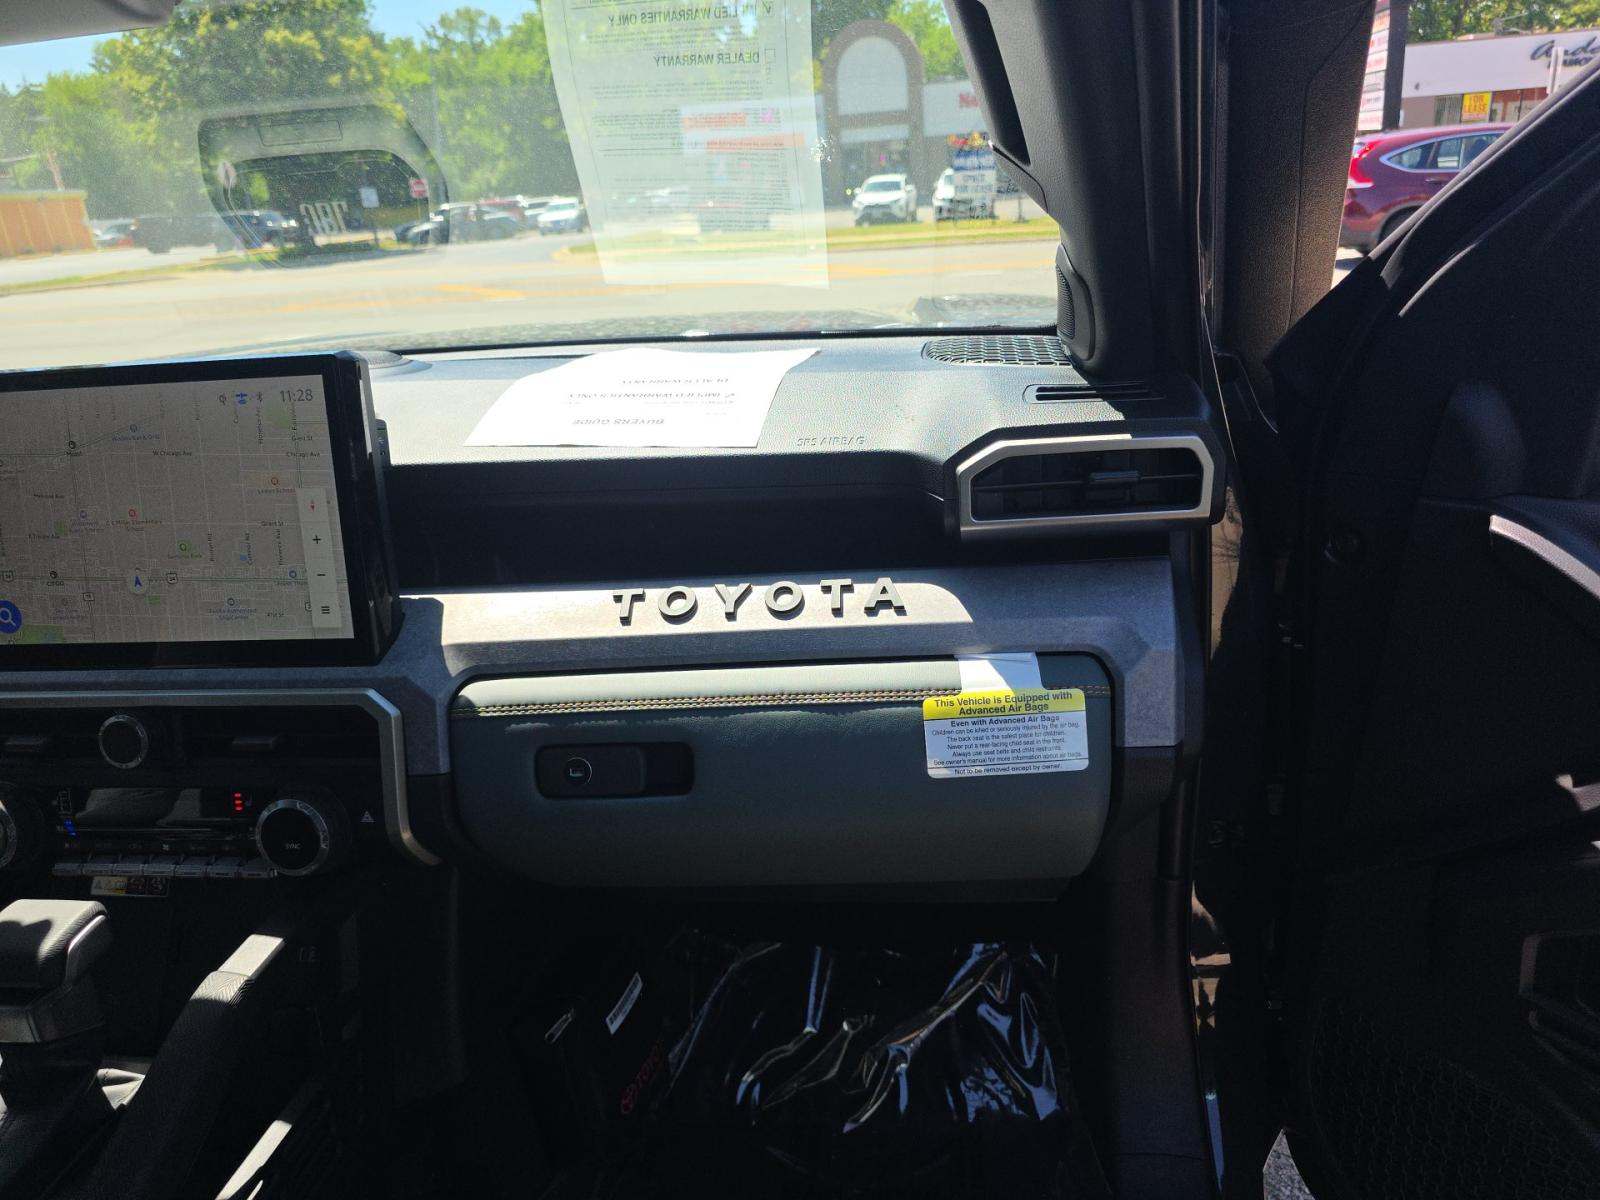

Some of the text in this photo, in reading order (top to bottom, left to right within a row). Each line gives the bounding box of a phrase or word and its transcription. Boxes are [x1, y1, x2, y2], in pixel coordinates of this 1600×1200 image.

[279, 388, 314, 403] 11:28
[612, 577, 907, 626] TOYOTA
[934, 691, 1073, 708] This Vehicle is Equipped with
[959, 703, 1049, 716] Advanced Air Bags
[988, 716, 1026, 726] Advanced
[1028, 715, 1038, 723] Air
[1040, 715, 1060, 724] Bags
[983, 765, 1010, 773] removed
[1033, 764, 1040, 772] by
[285, 841, 303, 851] SYNC
